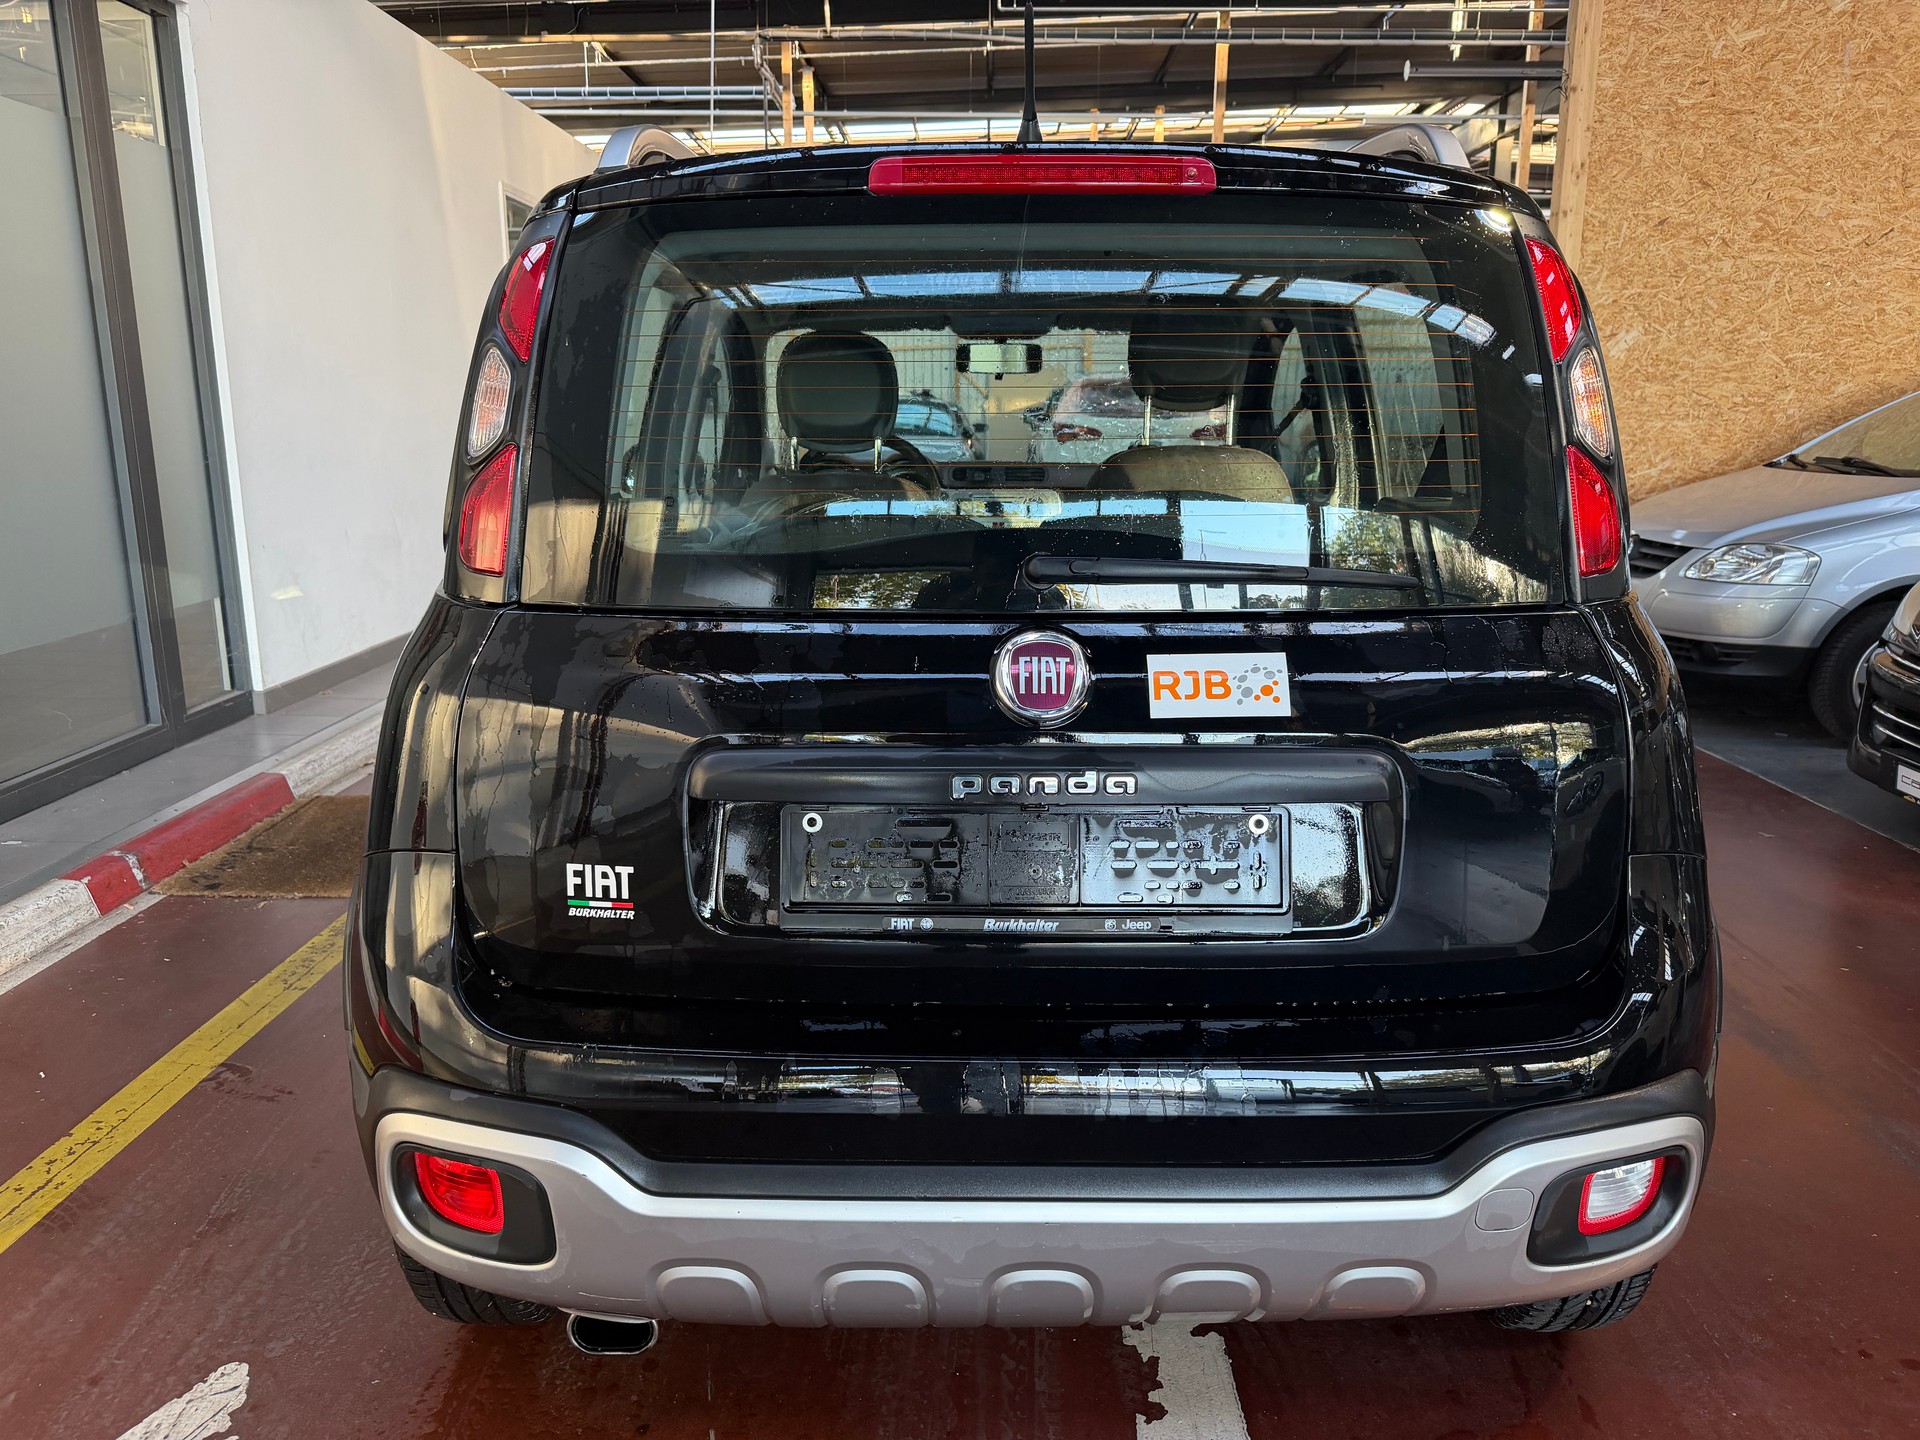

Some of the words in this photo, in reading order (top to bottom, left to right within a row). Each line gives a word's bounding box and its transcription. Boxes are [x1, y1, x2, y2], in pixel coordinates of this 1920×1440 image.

[1018, 656, 1070, 695] FIAT
[1153, 670, 1232, 701] RJB
[951, 770, 1137, 800] panda
[566, 863, 635, 900] FIAT
[568, 907, 636, 920] BURKHALTER
[890, 917, 915, 930] FIAT
[983, 918, 1060, 932] Burkhalter
[1121, 919, 1152, 931] Jeep
